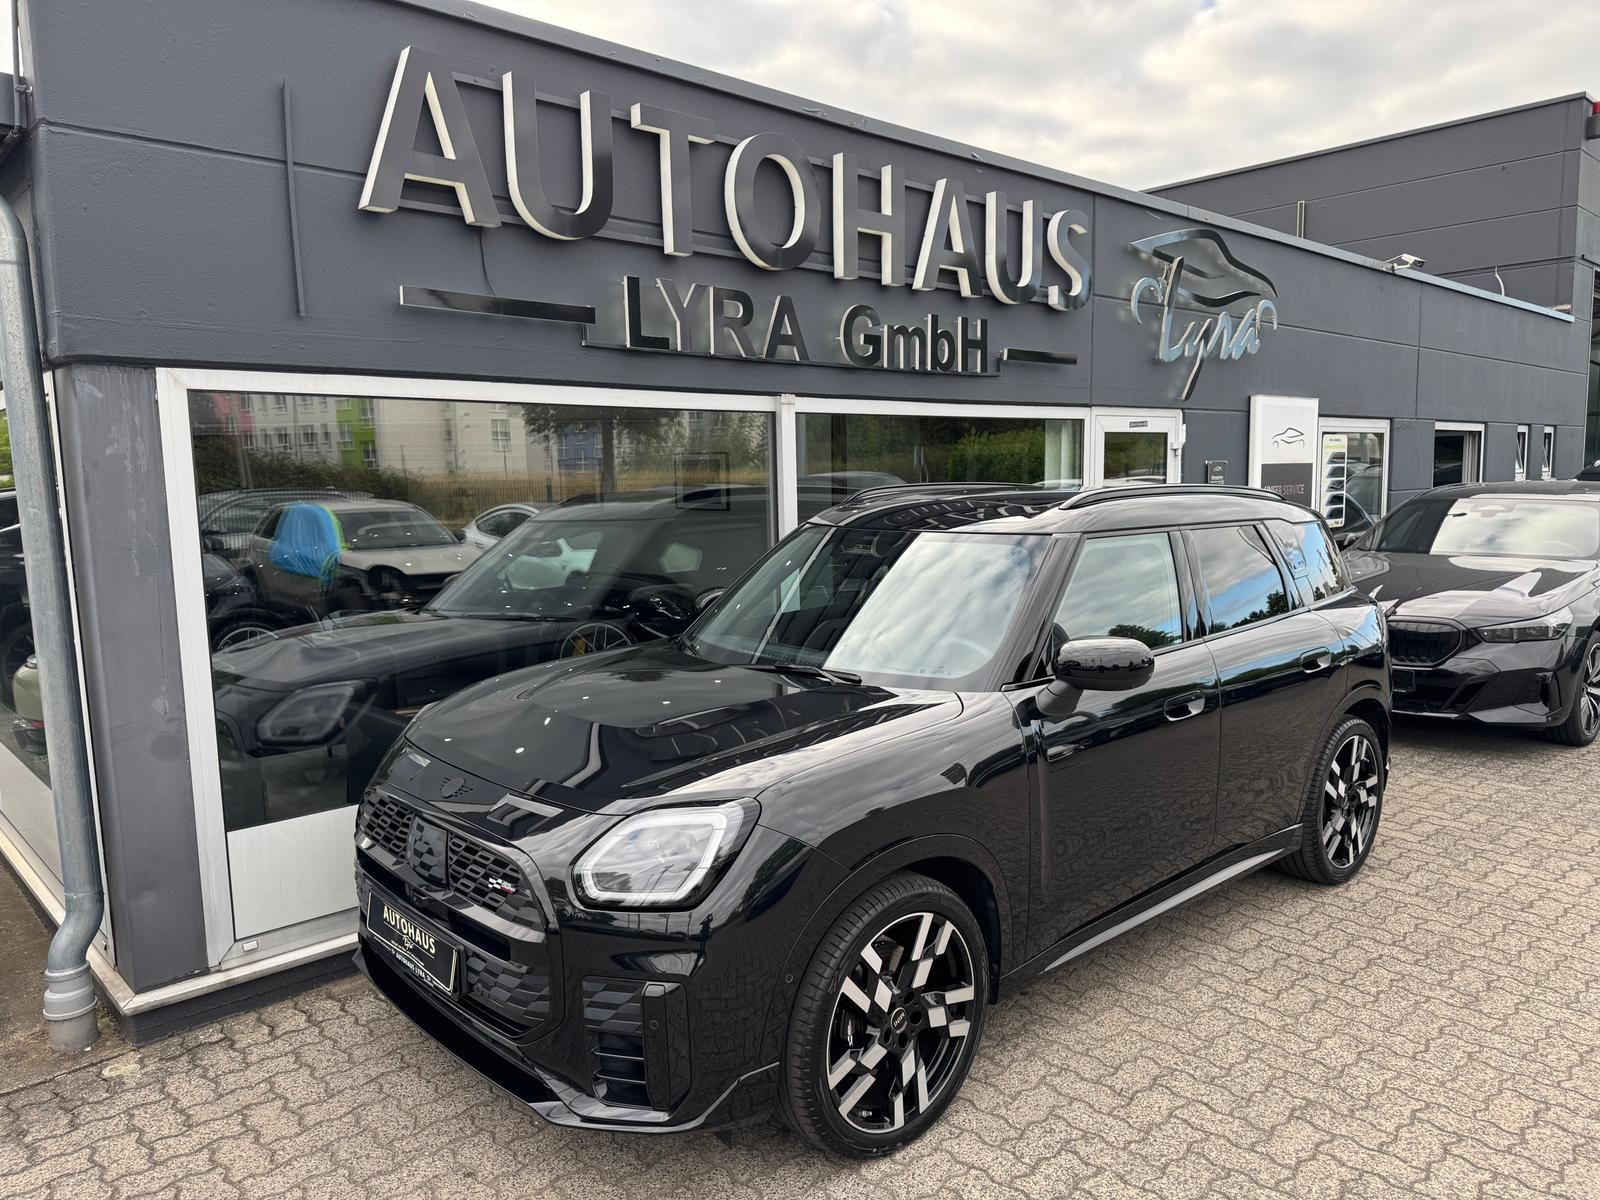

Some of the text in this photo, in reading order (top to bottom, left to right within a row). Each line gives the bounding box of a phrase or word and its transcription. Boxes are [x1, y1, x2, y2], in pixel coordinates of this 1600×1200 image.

[358, 45, 1093, 312] AUTOHAUS
[622, 274, 989, 375] LYRA GmbH
[1131, 256, 1278, 401] Lyra
[383, 905, 436, 954] AUTOHAUS
